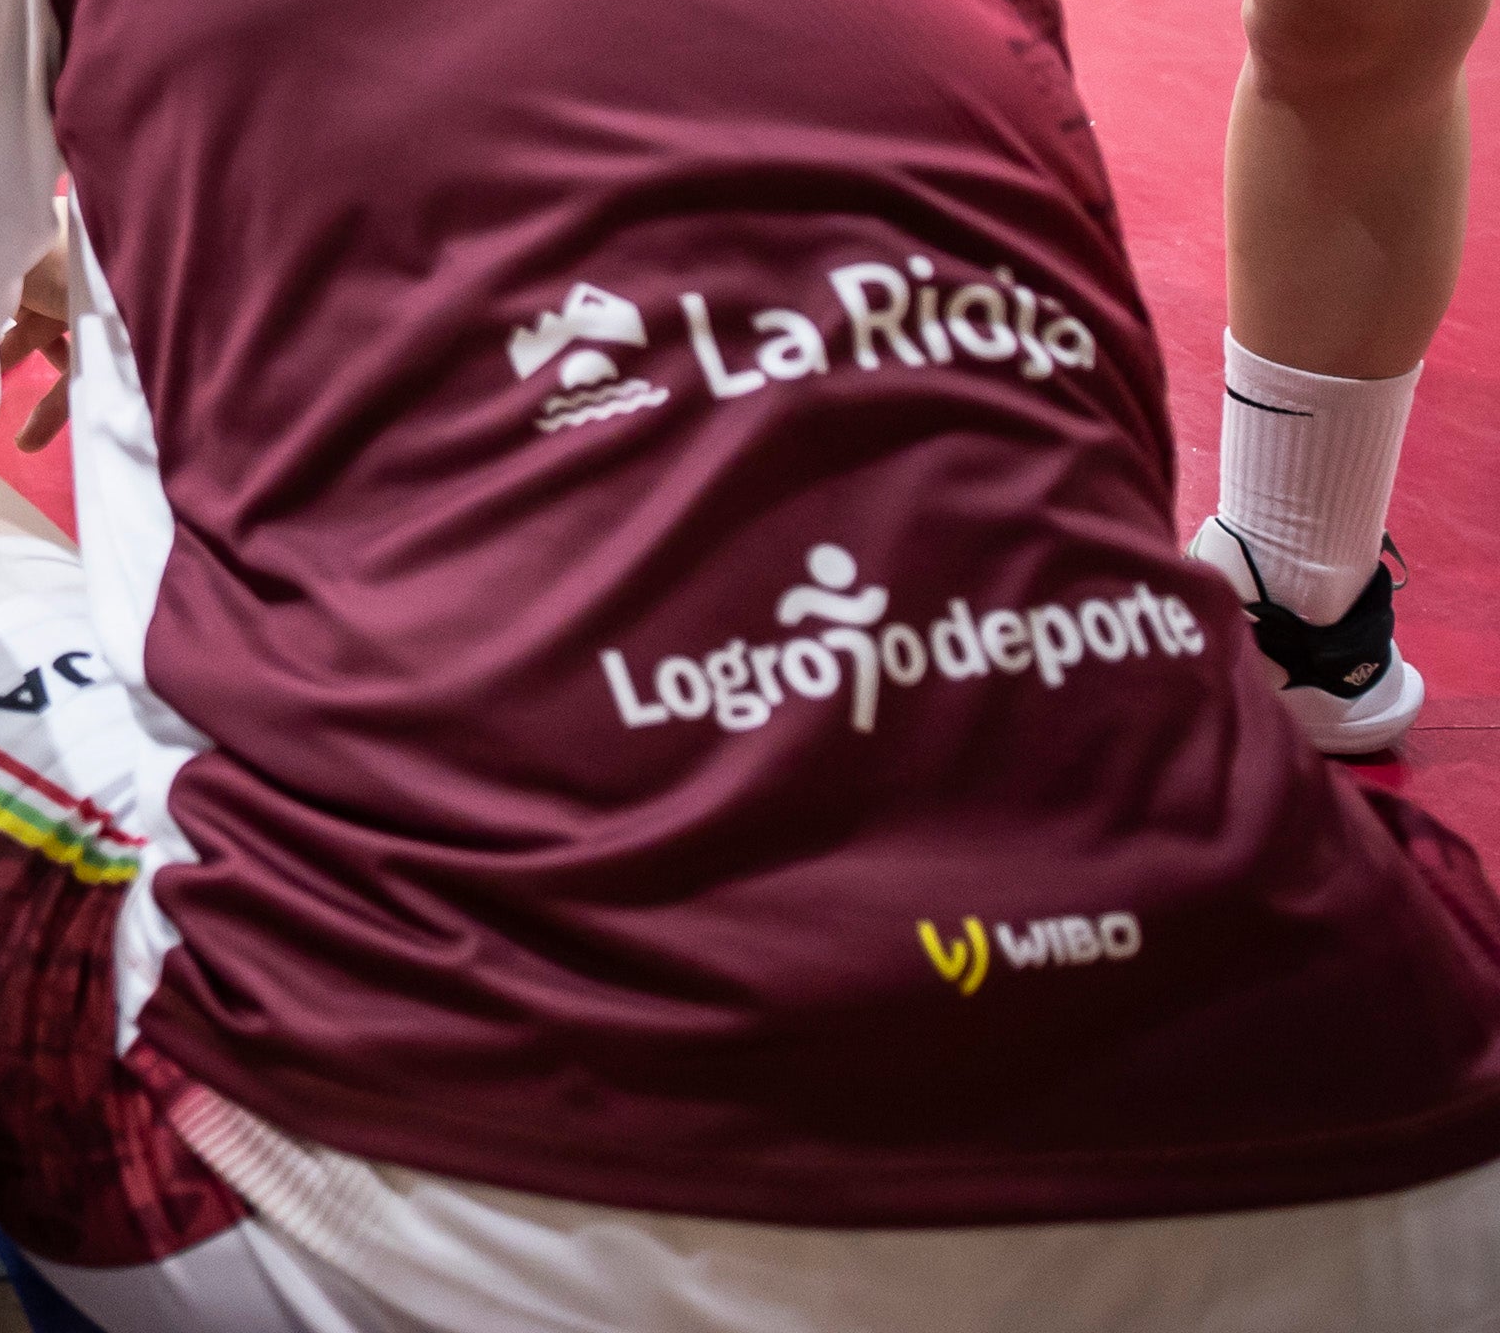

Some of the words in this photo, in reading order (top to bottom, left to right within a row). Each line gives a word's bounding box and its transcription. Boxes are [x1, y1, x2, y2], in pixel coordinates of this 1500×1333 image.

[679, 291, 832, 401] La
[830, 254, 1097, 381] Rioja
[929, 582, 1206, 689] deporte
[994, 910, 1142, 972] WIBO
